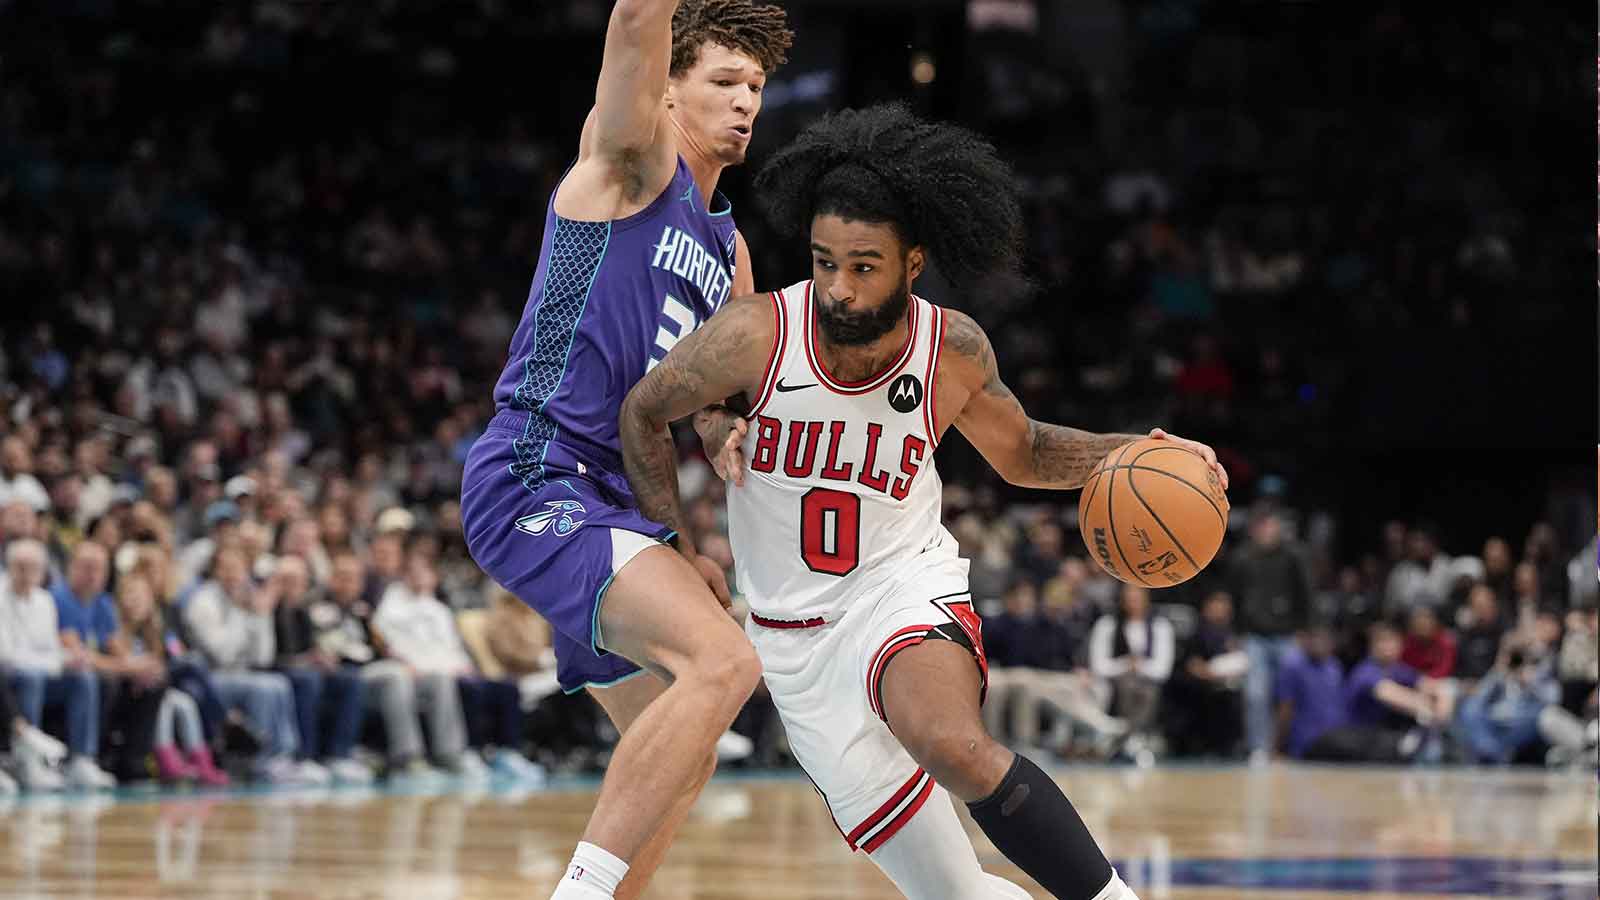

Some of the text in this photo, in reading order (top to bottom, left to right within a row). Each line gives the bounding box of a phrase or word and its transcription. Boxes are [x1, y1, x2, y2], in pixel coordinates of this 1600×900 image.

[652, 225, 732, 313] HORNET
[751, 414, 926, 501] BULLS
[801, 486, 861, 577] 0
